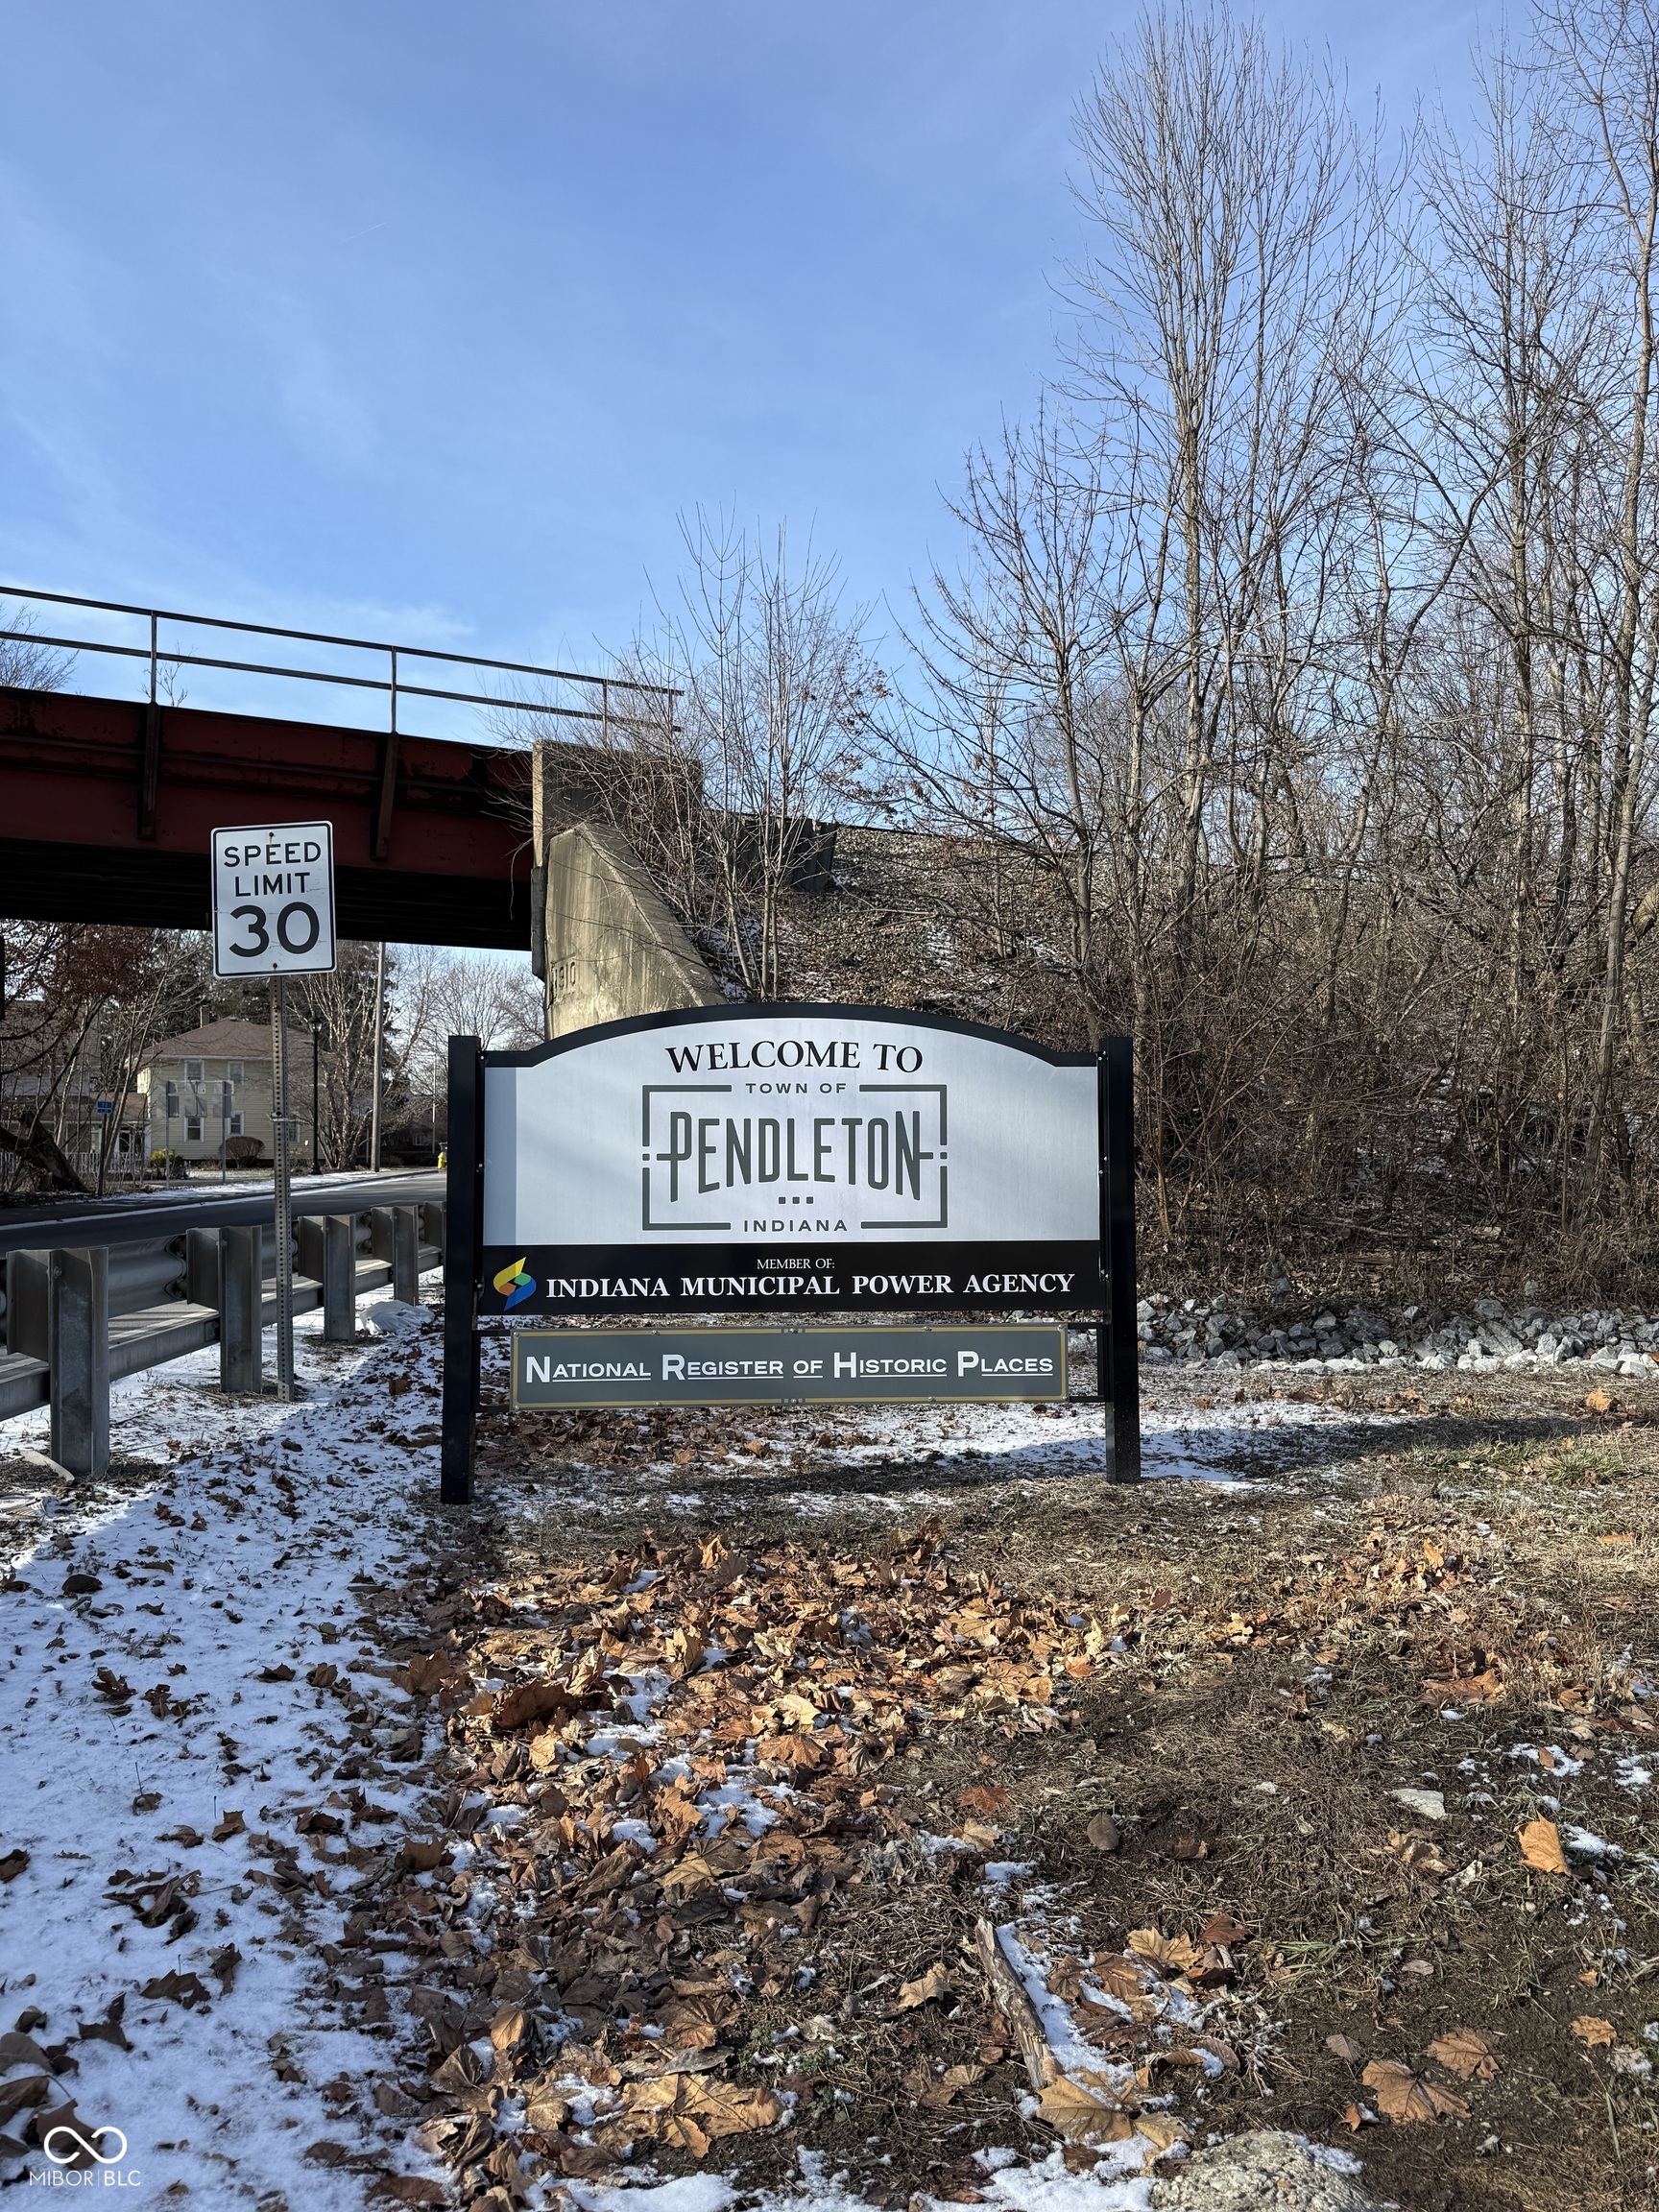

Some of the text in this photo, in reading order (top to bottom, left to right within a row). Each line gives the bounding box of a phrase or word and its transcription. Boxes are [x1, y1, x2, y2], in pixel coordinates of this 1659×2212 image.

[224, 842, 322, 868] SPEED
[235, 872, 311, 897] LIMIT
[228, 902, 320, 957] 30
[665, 1040, 924, 1073] WELCOME TO
[746, 1083, 847, 1094] TOWN OF
[657, 1110, 934, 1203] PENDLETON
[743, 1219, 848, 1233] INDIANA
[757, 1258, 835, 1270] MEMBER OF:
[545, 1273, 1075, 1298] INDIANA MUNICIPAL POWER AGENCY
